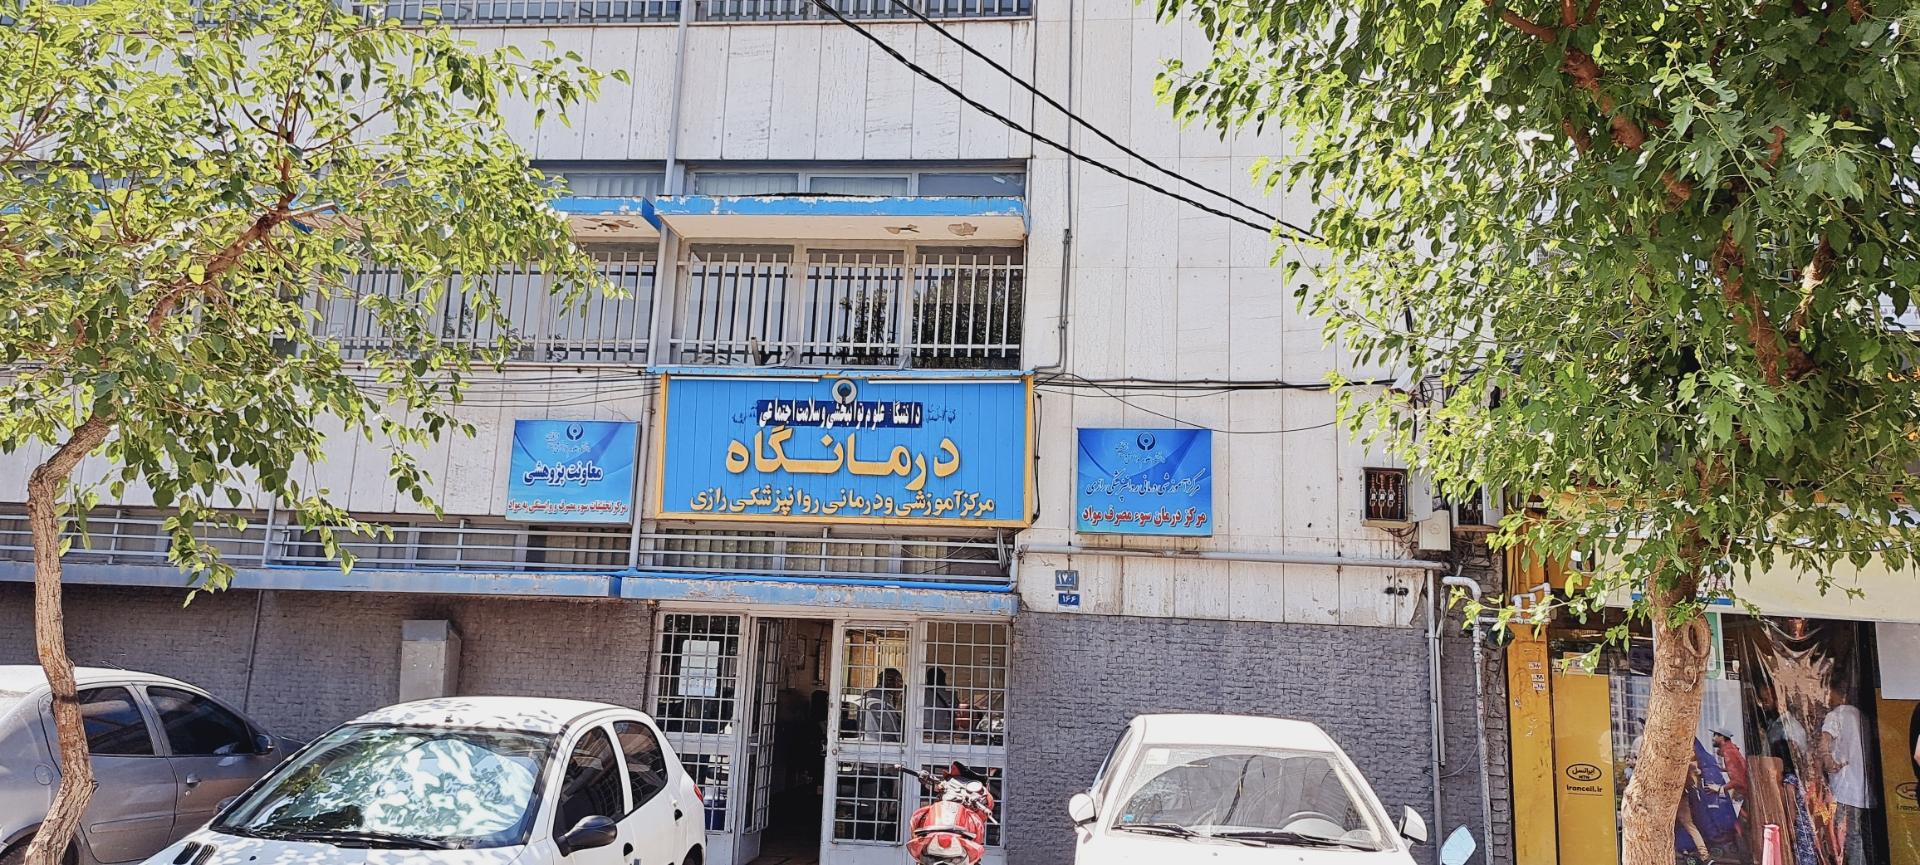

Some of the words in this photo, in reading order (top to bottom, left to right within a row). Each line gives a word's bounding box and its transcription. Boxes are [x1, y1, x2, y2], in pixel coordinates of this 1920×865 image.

[759, 397, 796, 428] اجتماعی
[796, 397, 820, 422] سلامت
[865, 399, 885, 431] علوم
[725, 424, 961, 492] درمانگاه
[523, 460, 565, 487] پژوهشی
[567, 460, 604, 487] معاونت
[508, 498, 522, 513] مواد
[558, 499, 576, 514] مصرف
[577, 503, 589, 514] سوء
[610, 499, 628, 515] مرکز
[690, 487, 728, 512] رازی
[728, 484, 821, 517] روانپزشکی
[821, 488, 882, 516] درمانی
[895, 490, 964, 517] آموزشی
[959, 491, 996, 517] مرکز
[1082, 504, 1103, 527] مواد
[1104, 504, 1133, 527] مصرف
[1134, 512, 1152, 527] سوء
[1153, 505, 1182, 527] درمان
[1184, 506, 1207, 527] مرکز
